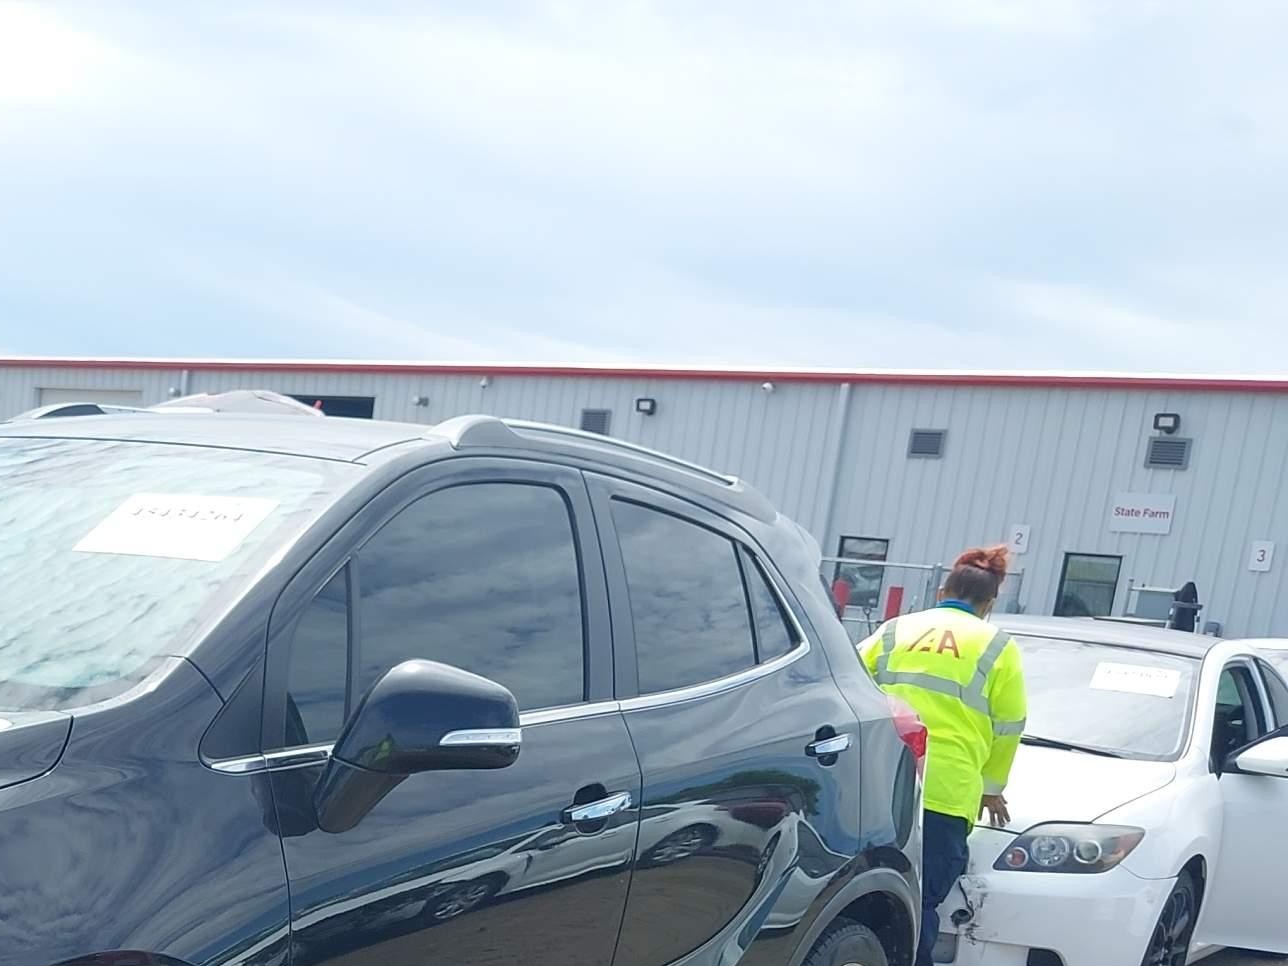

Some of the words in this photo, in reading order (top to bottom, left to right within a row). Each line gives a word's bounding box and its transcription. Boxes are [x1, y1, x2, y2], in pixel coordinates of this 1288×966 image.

[1114, 506, 1141, 518] State
[1143, 507, 1170, 519] Farm
[1014, 532, 1024, 545] 2
[1256, 549, 1267, 562] 3
